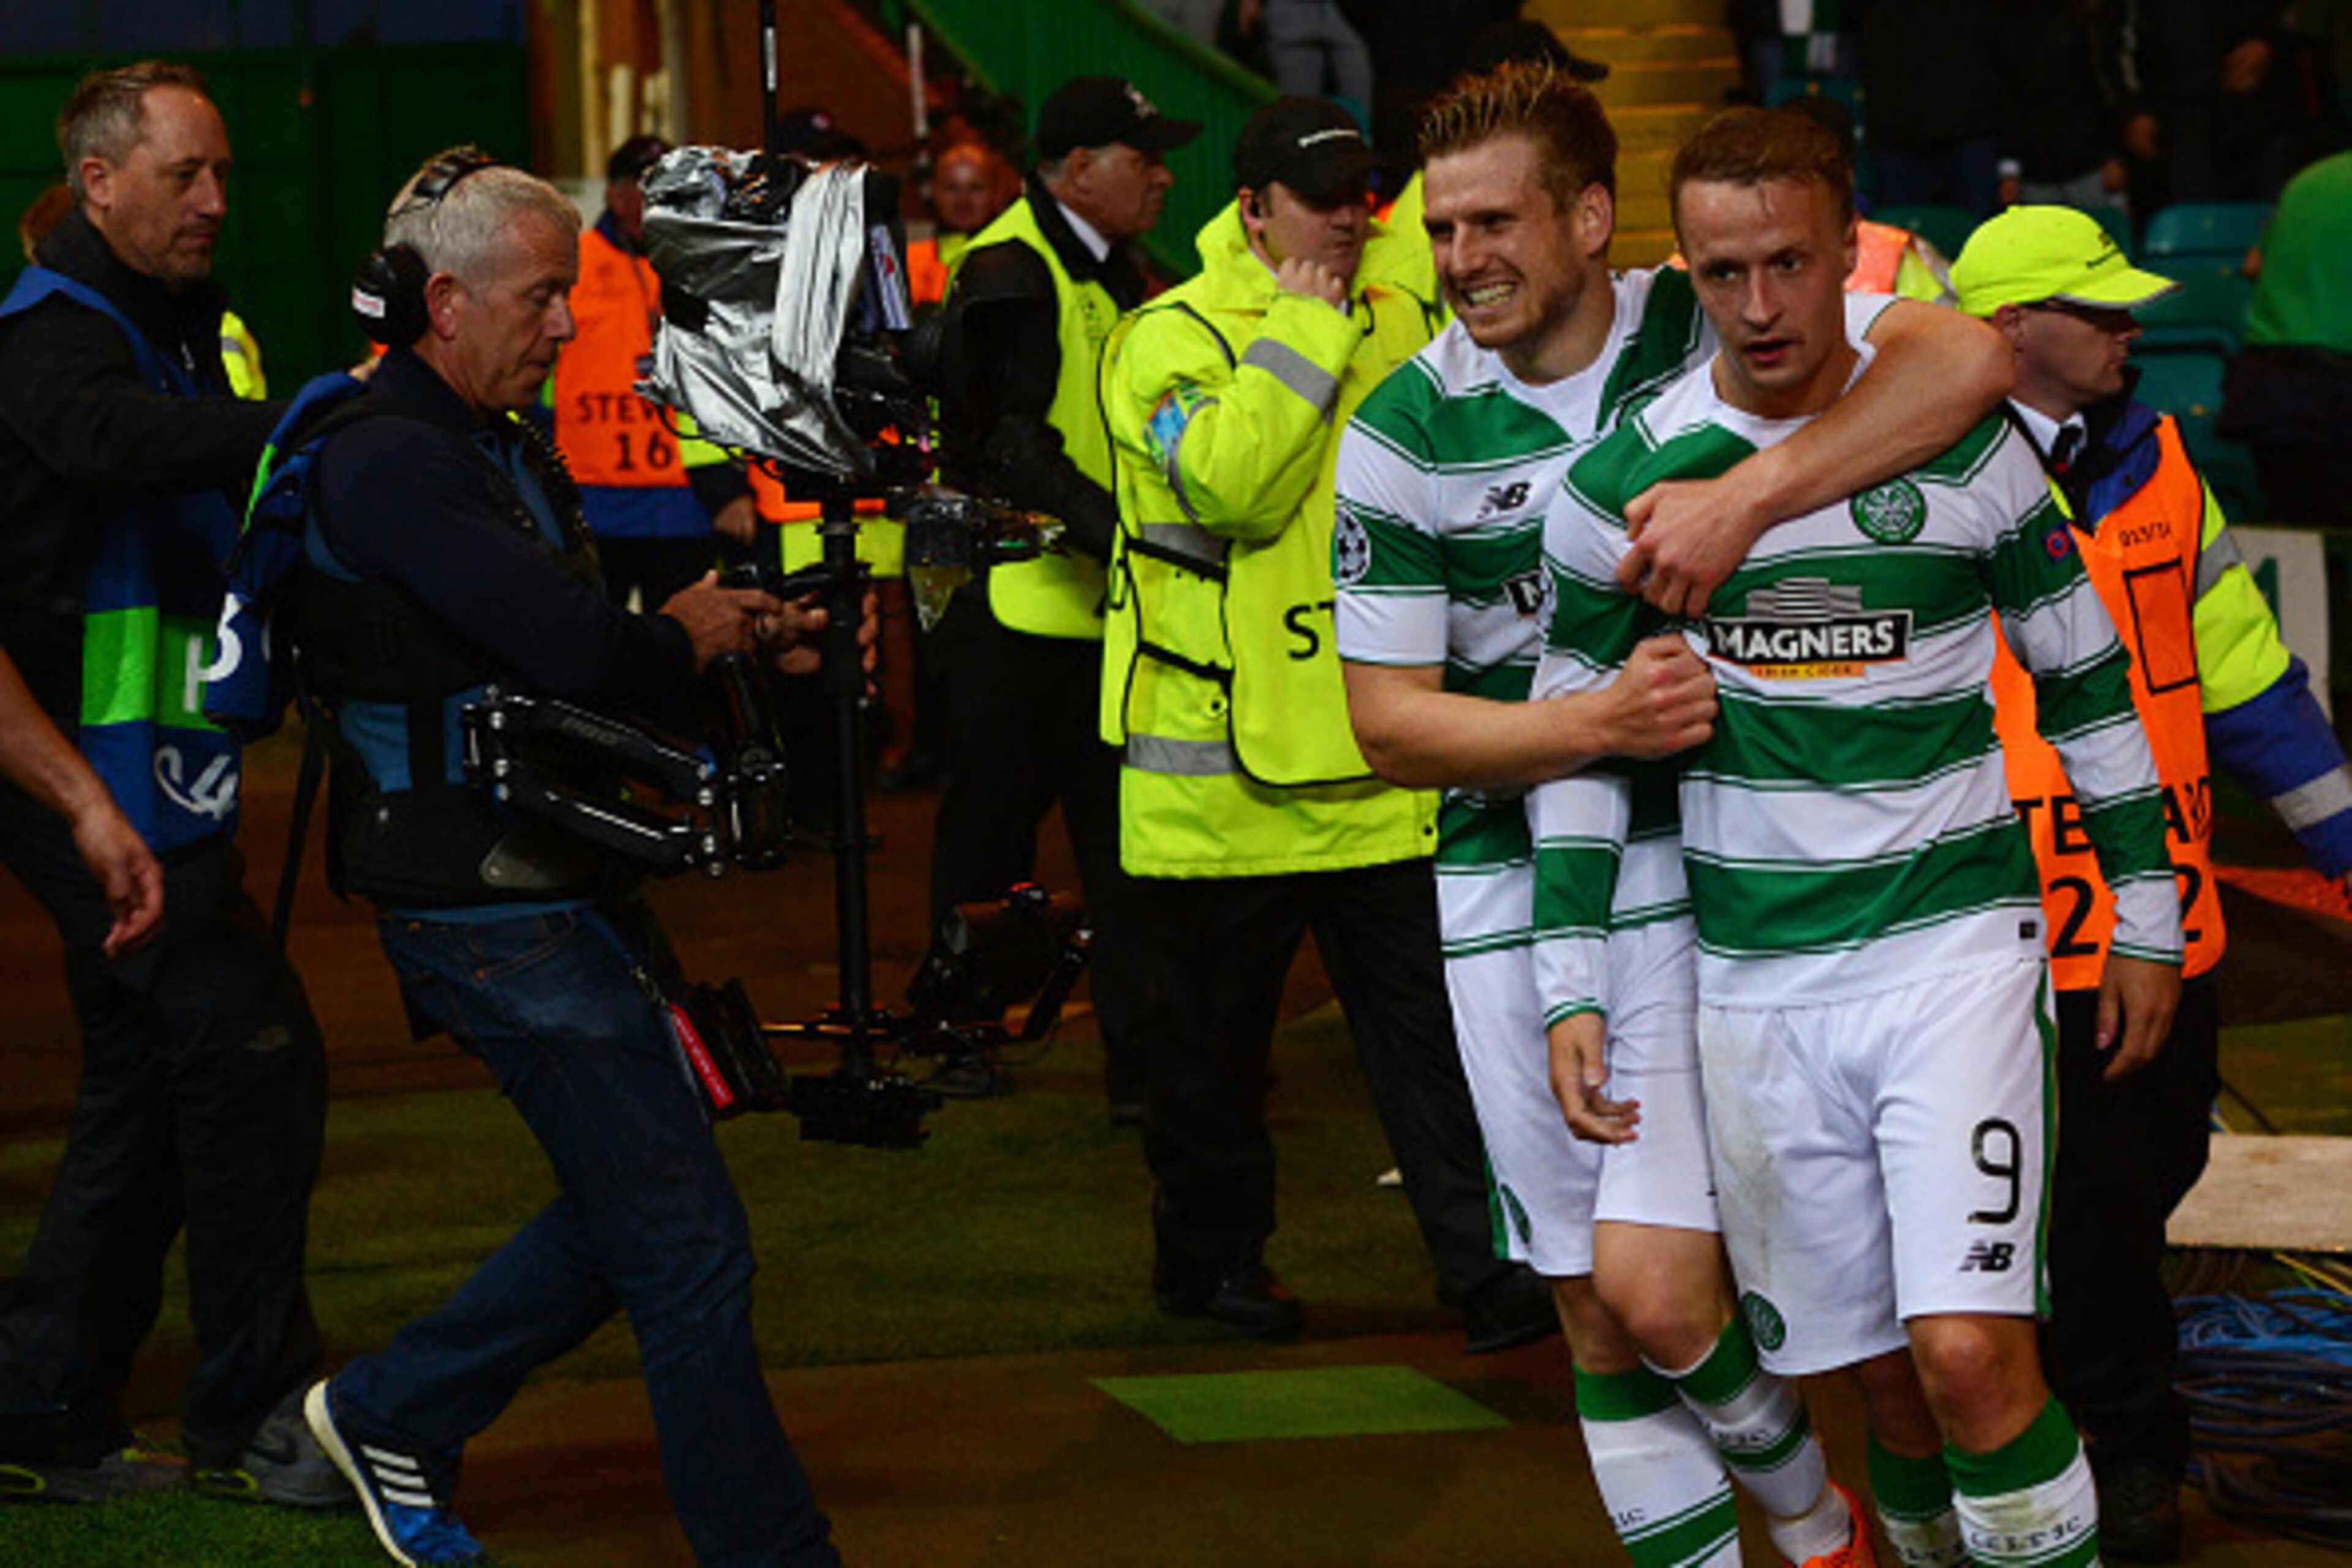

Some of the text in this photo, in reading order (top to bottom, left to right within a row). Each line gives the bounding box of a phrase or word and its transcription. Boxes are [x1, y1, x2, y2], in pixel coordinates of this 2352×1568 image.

[615, 431, 673, 471] 16
[1713, 620, 1894, 660] MAGNERS
[1967, 1116, 2021, 1225] 9
